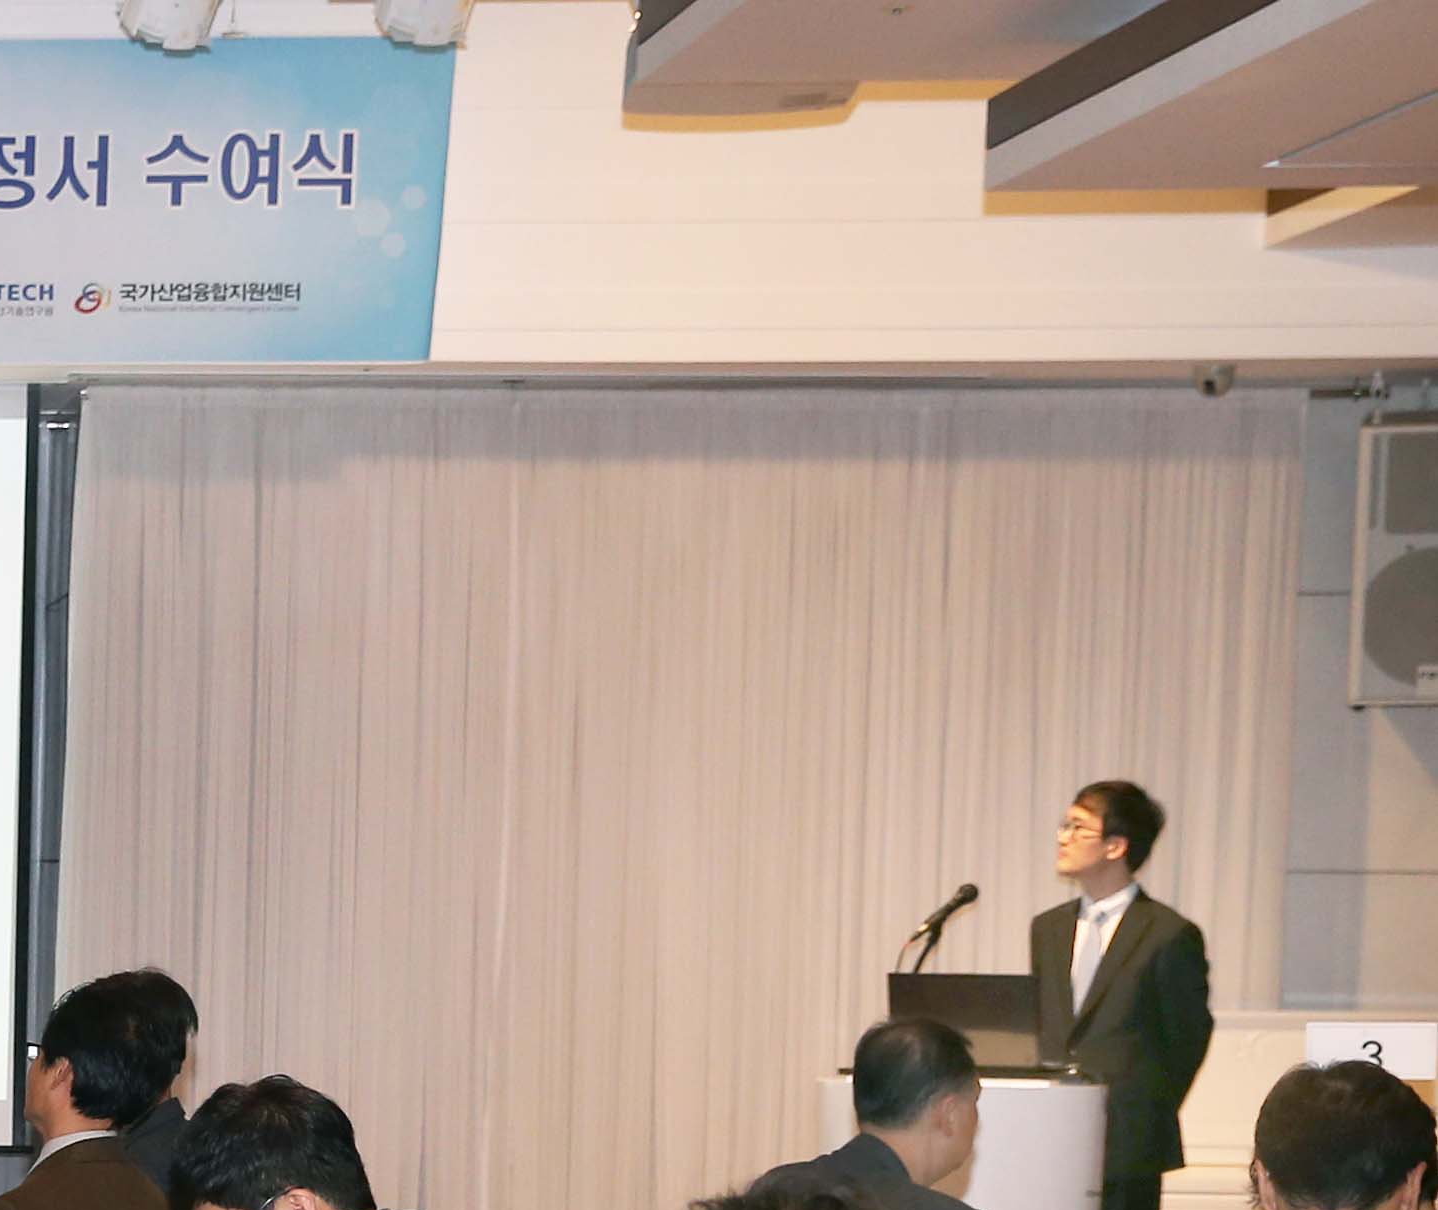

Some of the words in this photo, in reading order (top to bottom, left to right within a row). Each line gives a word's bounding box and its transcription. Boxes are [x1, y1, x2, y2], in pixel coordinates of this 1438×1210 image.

[146, 133, 354, 206] 수여식
[119, 282, 302, 303] 국가산업융합지원센터
[1361, 1040, 1384, 1067] 3
